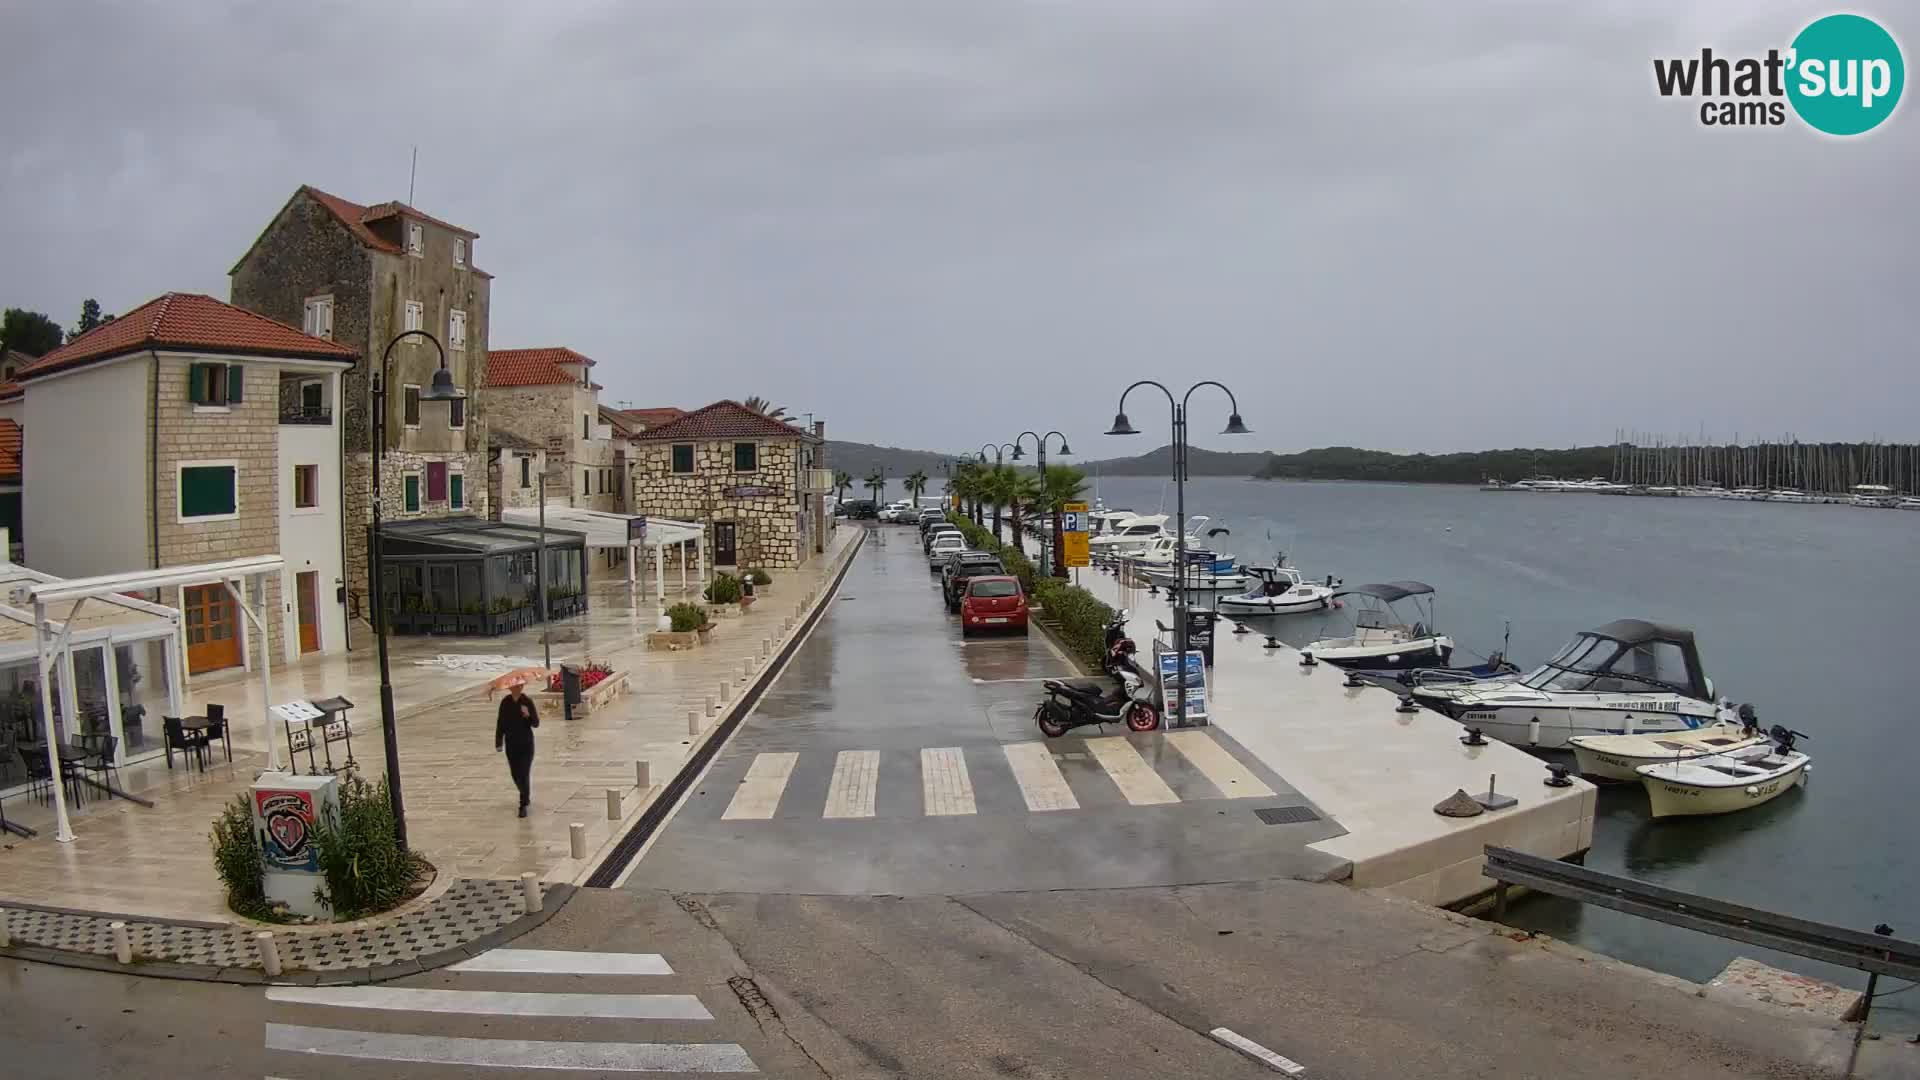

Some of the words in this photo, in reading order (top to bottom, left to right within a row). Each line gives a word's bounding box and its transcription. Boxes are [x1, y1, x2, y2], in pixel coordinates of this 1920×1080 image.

[1066, 514, 1076, 529] P
[1640, 701, 1657, 711] RENT
[1664, 702, 1680, 713] BOAT
